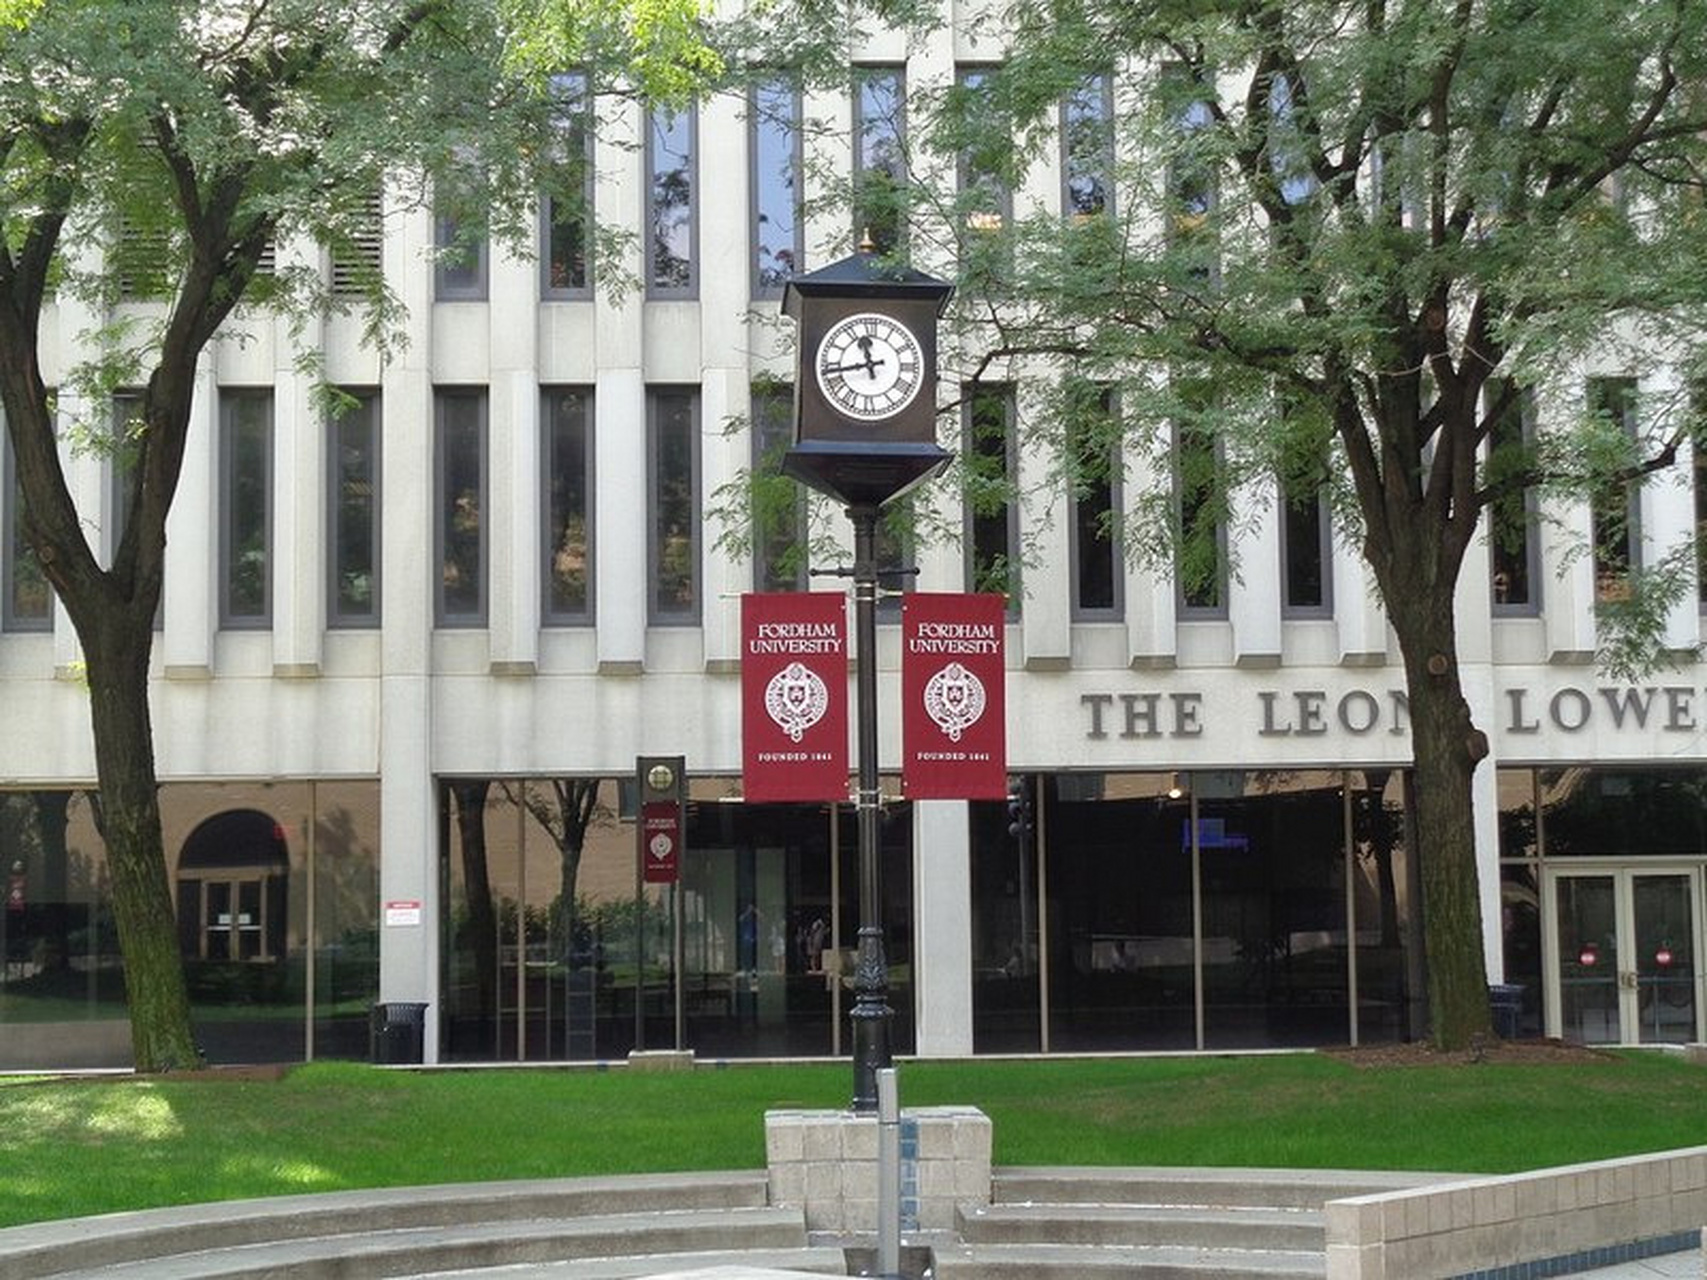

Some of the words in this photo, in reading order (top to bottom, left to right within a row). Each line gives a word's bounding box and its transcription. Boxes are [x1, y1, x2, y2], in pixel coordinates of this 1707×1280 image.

[758, 623, 836, 637] FORDHAM
[918, 623, 995, 637] FORDHAM
[750, 638, 842, 653] UNIVERSITY
[910, 638, 1000, 653] UNIVERSITY
[1081, 692, 1204, 739] THE
[1505, 687, 1707, 733] LOWE
[758, 753, 808, 762] FOUNDED
[917, 753, 966, 762] FOUNDED
